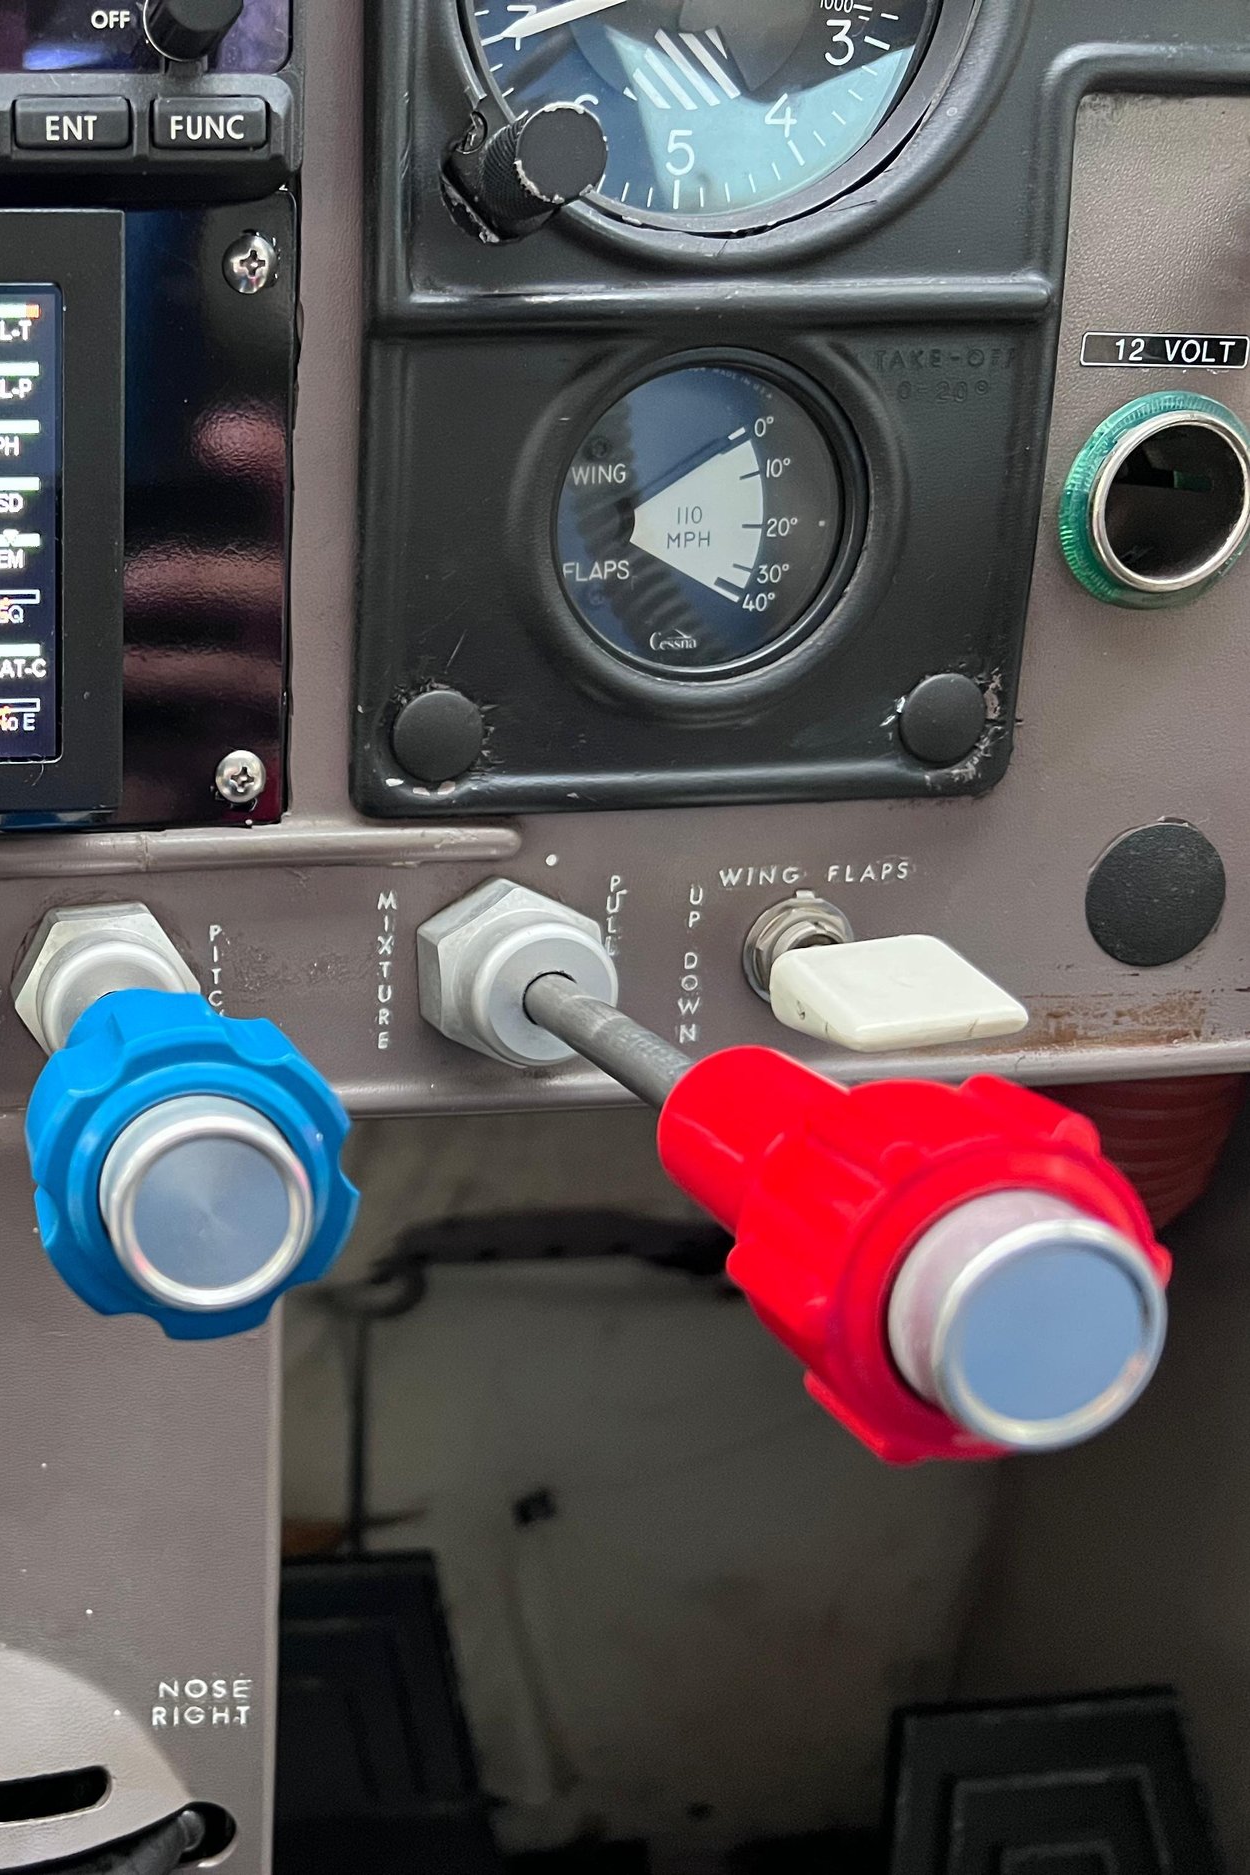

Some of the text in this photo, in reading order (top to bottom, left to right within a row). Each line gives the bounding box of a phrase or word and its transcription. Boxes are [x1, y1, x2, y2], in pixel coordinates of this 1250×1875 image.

[90, 9, 131, 30] OFF
[824, 19, 855, 66] 3
[44, 114, 98, 142] ENT
[169, 114, 245, 141] FUNC
[764, 94, 797, 138] 4
[666, 129, 695, 176] 5
[1115, 337, 1237, 364] 12 VOLT
[754, 416, 775, 438] 0°
[571, 463, 626, 486] WING
[766, 457, 791, 479] 10°
[676, 506, 703, 525] 110
[766, 517, 799, 538] 20°
[666, 530, 711, 549] MPH
[562, 559, 630, 583] FLAPS
[756, 563, 790, 585] 30°
[741, 592, 776, 613] 40°
[649, 630, 697, 652] Cessna
[719, 861, 910, 888] WING FLAPS
[208, 924, 225, 1016] PITC
[376, 890, 397, 1050] MIXTURE
[677, 883, 704, 1044] UP DOWN
[158, 1677, 253, 1701] NOSE
[151, 1703, 253, 1728] RIGHT
